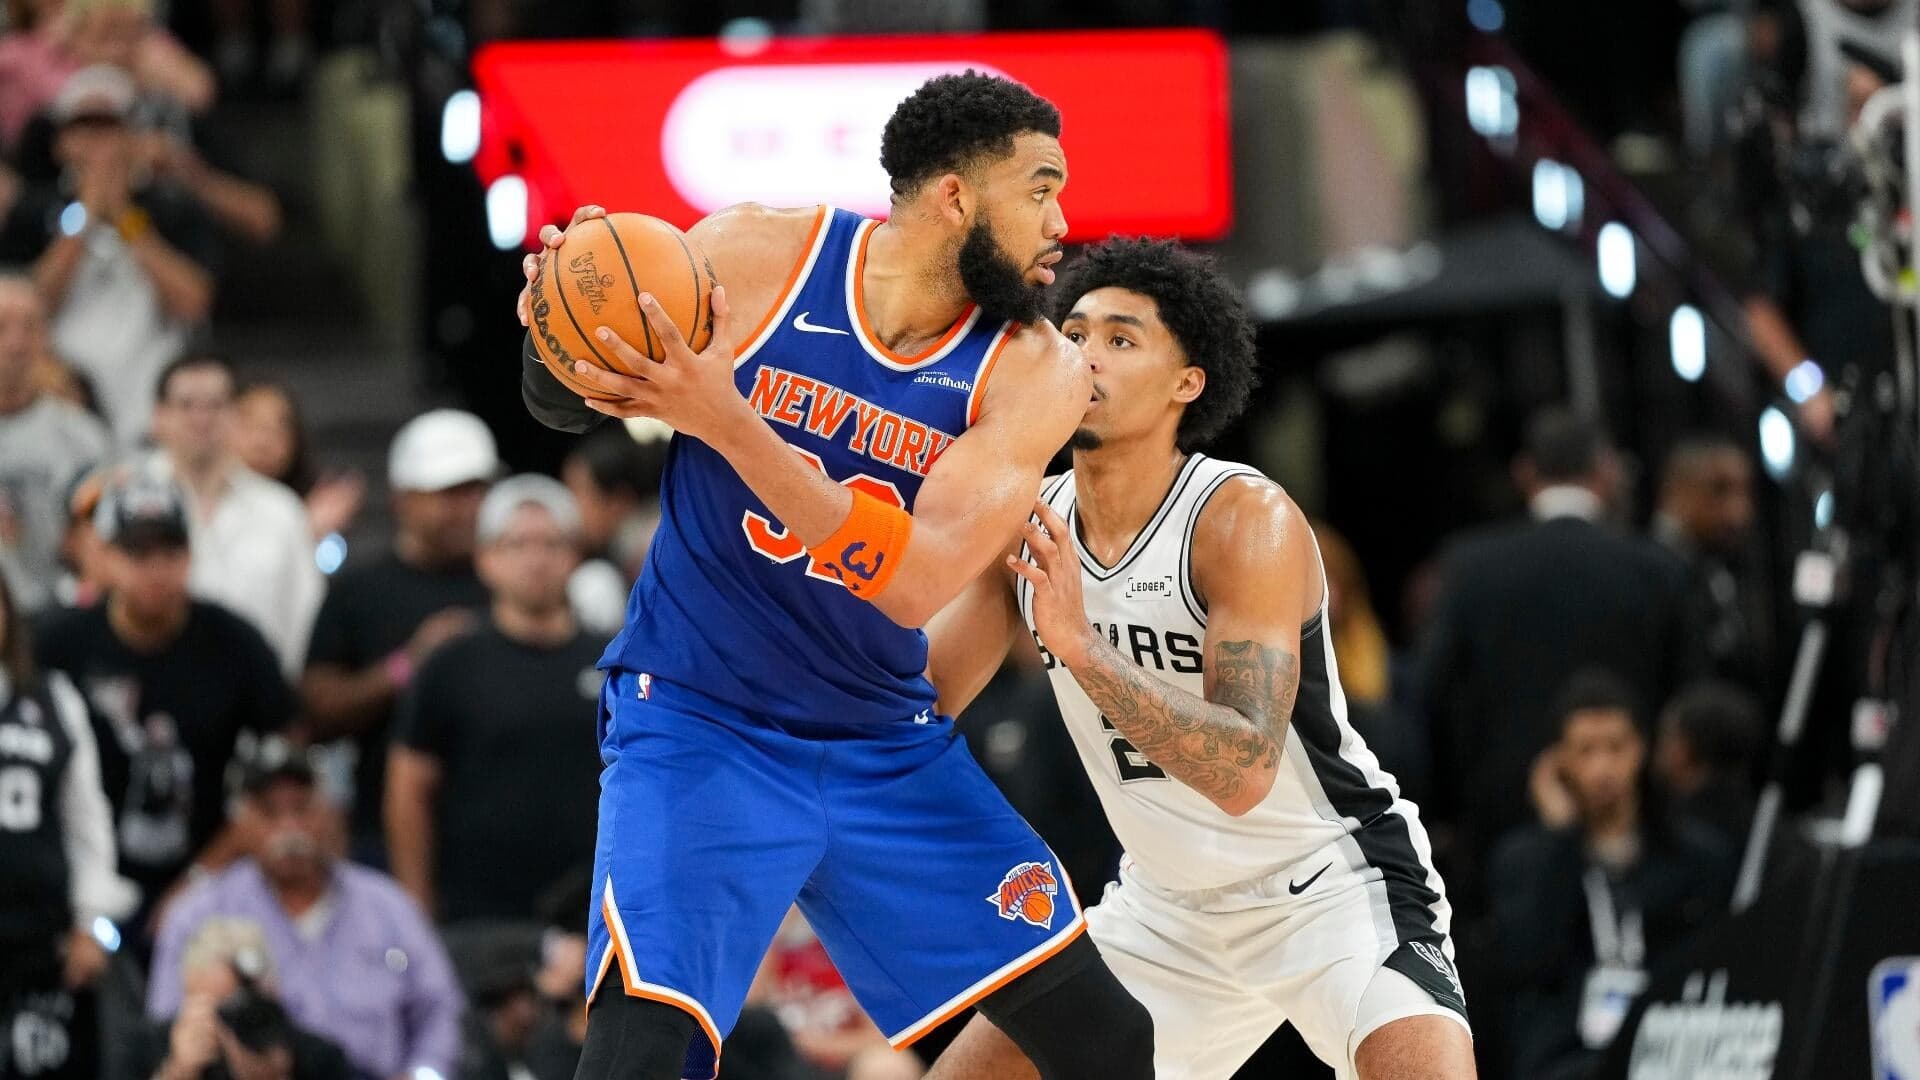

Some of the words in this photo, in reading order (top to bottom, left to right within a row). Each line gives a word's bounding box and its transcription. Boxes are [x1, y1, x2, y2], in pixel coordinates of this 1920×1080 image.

[914, 374, 936, 383] abu
[938, 376, 973, 392] dhabi
[750, 364, 858, 440] NEW
[1131, 581, 1165, 592] LEDGER
